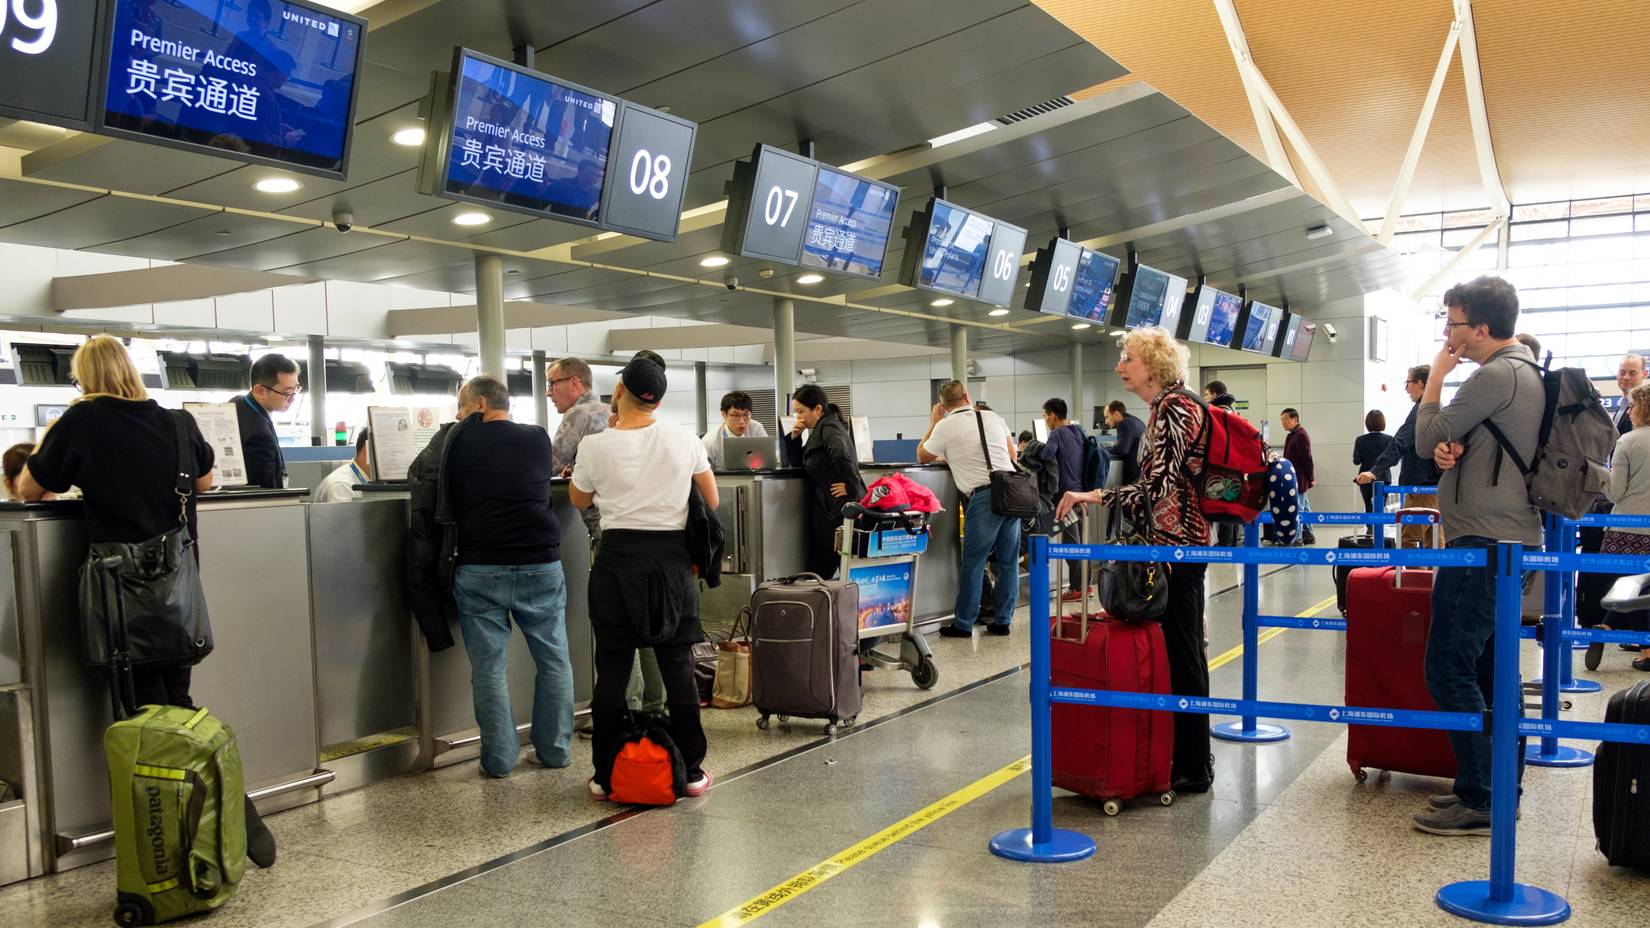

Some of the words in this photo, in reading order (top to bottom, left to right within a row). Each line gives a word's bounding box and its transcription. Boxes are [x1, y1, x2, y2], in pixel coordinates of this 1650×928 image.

[0, 0, 58, 55] 9
[282, 11, 327, 31] UNITED
[131, 29, 200, 62] Premier
[203, 49, 257, 77] Access
[126, 59, 260, 121] 贵宾通道
[564, 95, 594, 110] UNITED
[466, 116, 511, 139] Premier
[511, 129, 546, 149] Access
[460, 138, 547, 183] 贵宾通道
[630, 149, 672, 200] 08
[764, 185, 799, 228] 07
[815, 208, 838, 223] Premier
[838, 213, 857, 228] Access
[811, 224, 857, 252] 贵宾通道
[993, 249, 1013, 281] 06
[1053, 263, 1072, 293] 05
[1166, 295, 1179, 318] 04
[1197, 304, 1210, 326] 03
[145, 785, 171, 875] patagonia
